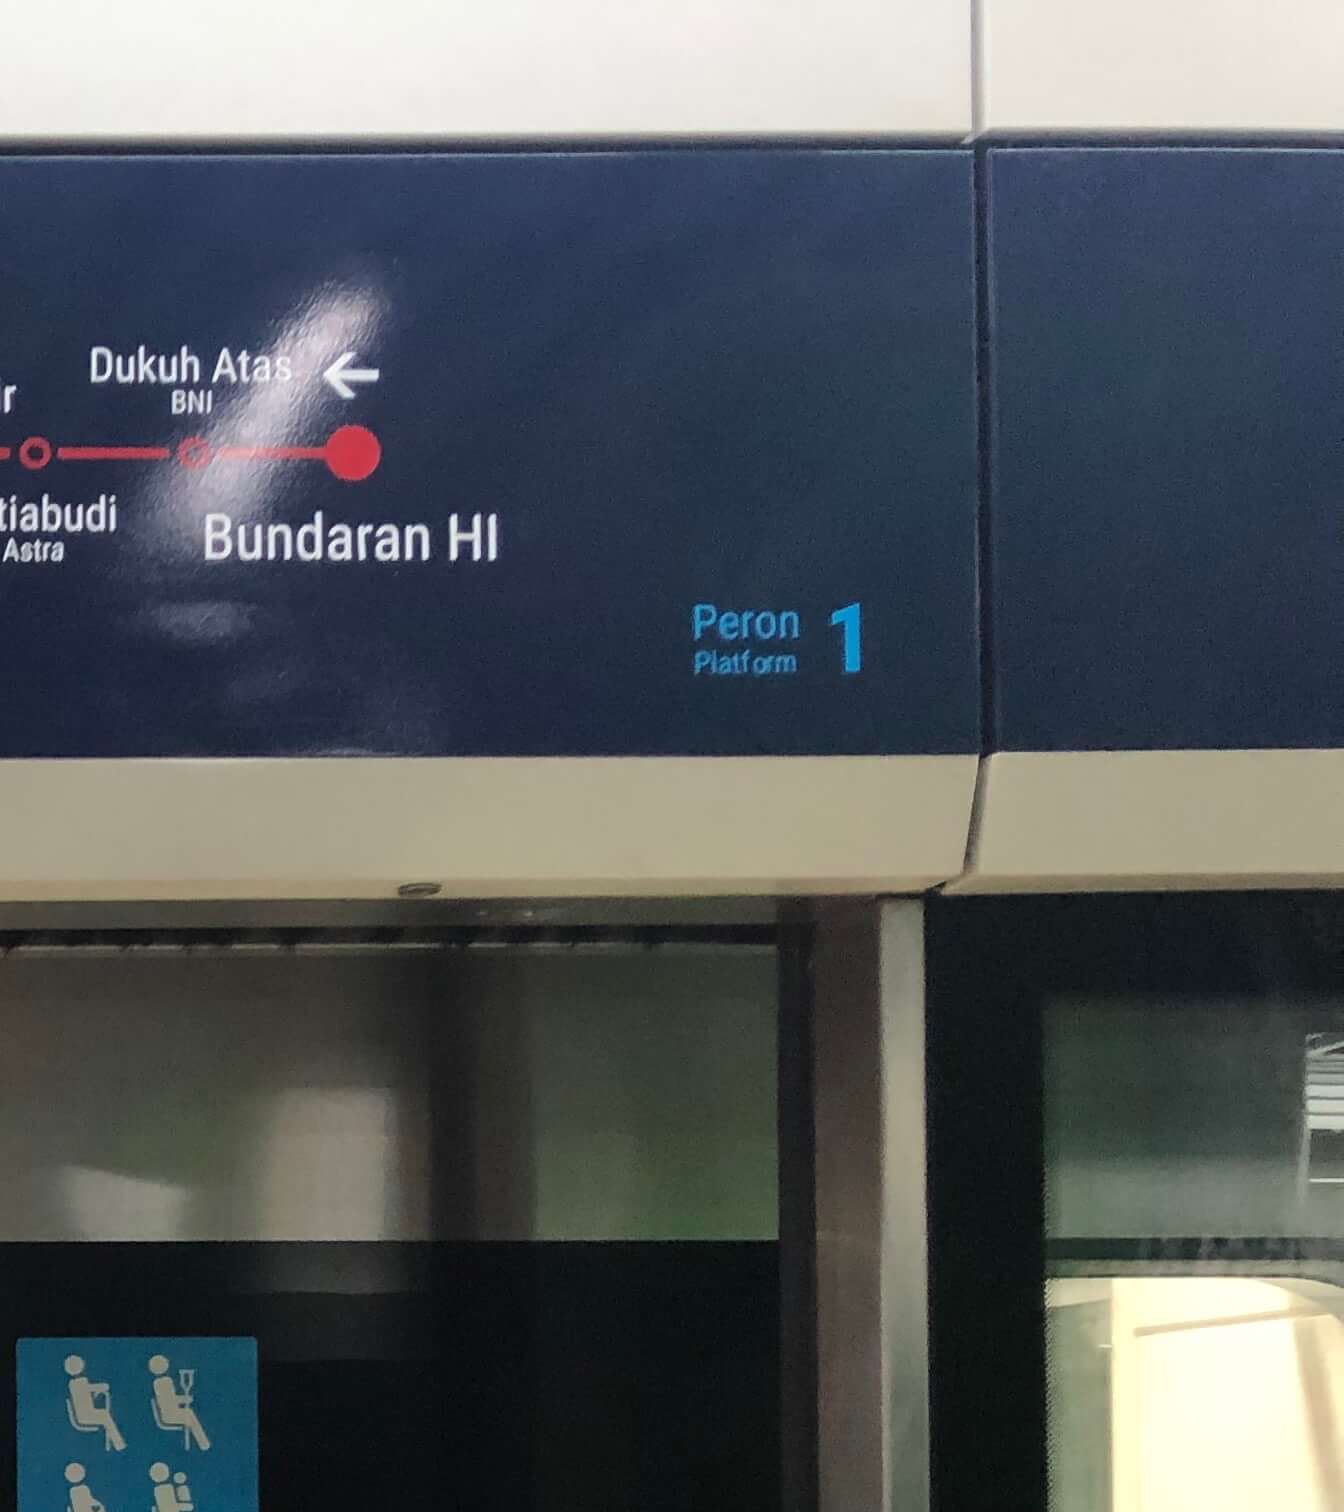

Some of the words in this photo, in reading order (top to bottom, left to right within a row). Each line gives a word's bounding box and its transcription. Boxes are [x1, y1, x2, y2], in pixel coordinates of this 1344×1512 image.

[90, 345, 200, 383] Dukuh
[211, 346, 294, 385] Atas
[171, 389, 213, 415] BNI
[2, 537, 65, 563] Astra
[203, 509, 431, 562] Bundaran
[449, 513, 497, 562] HI
[693, 603, 799, 641] Peron
[831, 602, 861, 673] 1
[694, 649, 797, 675] Platform
